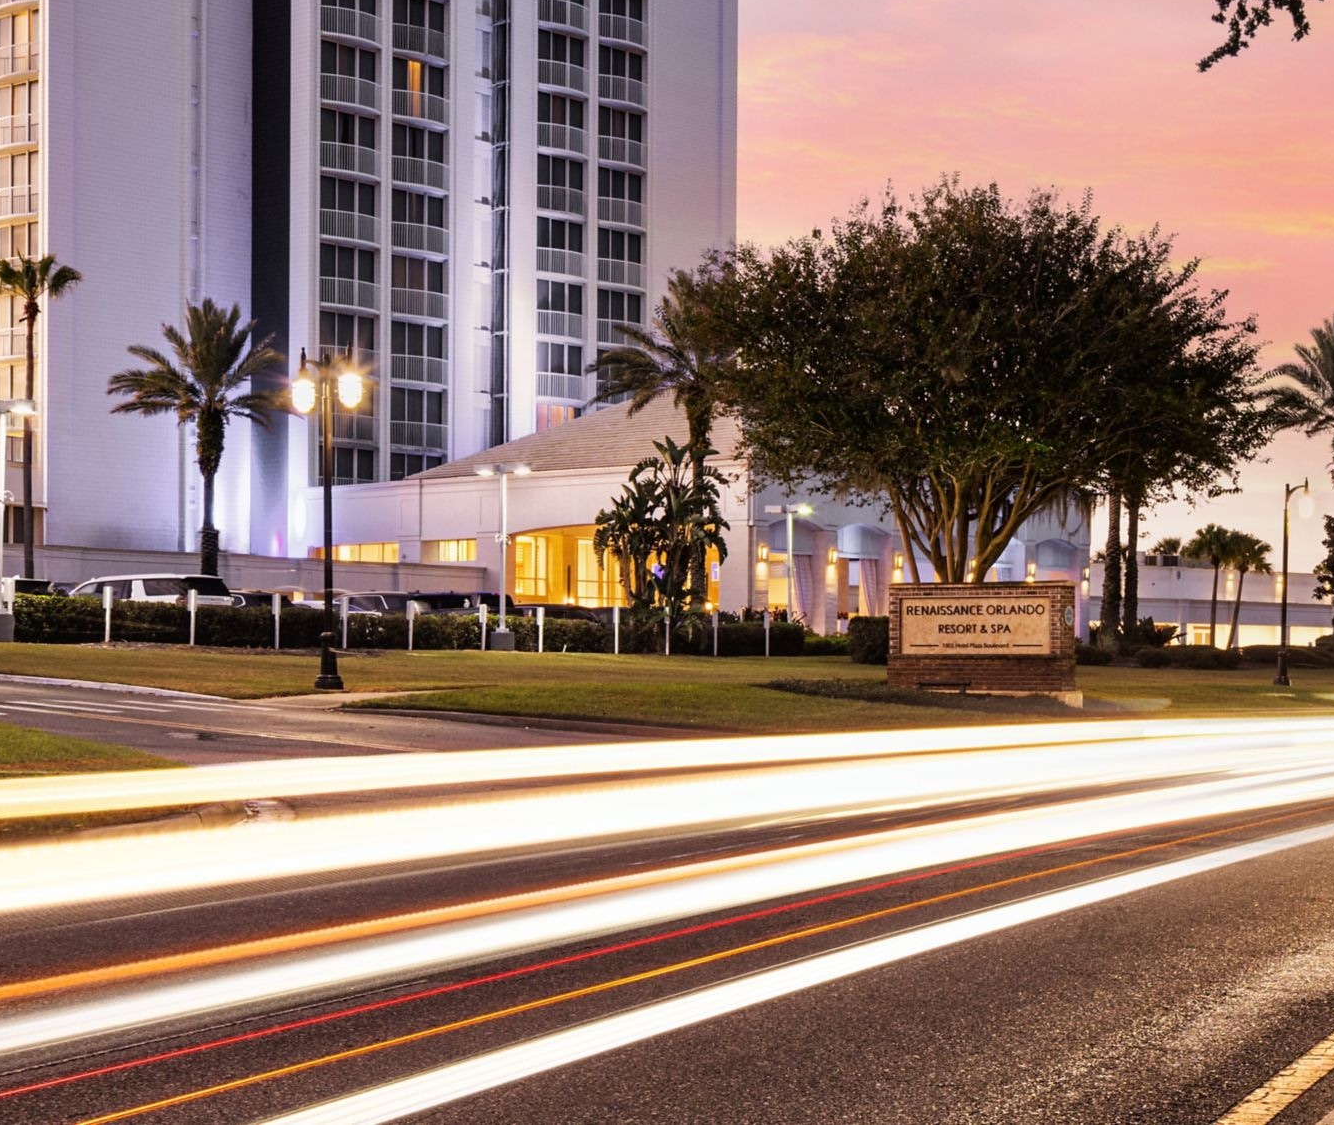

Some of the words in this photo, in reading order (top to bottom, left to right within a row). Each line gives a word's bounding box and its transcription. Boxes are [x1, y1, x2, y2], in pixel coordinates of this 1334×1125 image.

[906, 605, 983, 616] RENAISSANCE
[986, 604, 1045, 615] ORLANDO
[938, 624, 977, 634] RESORT
[980, 624, 987, 634] &
[991, 624, 1011, 634] SPA
